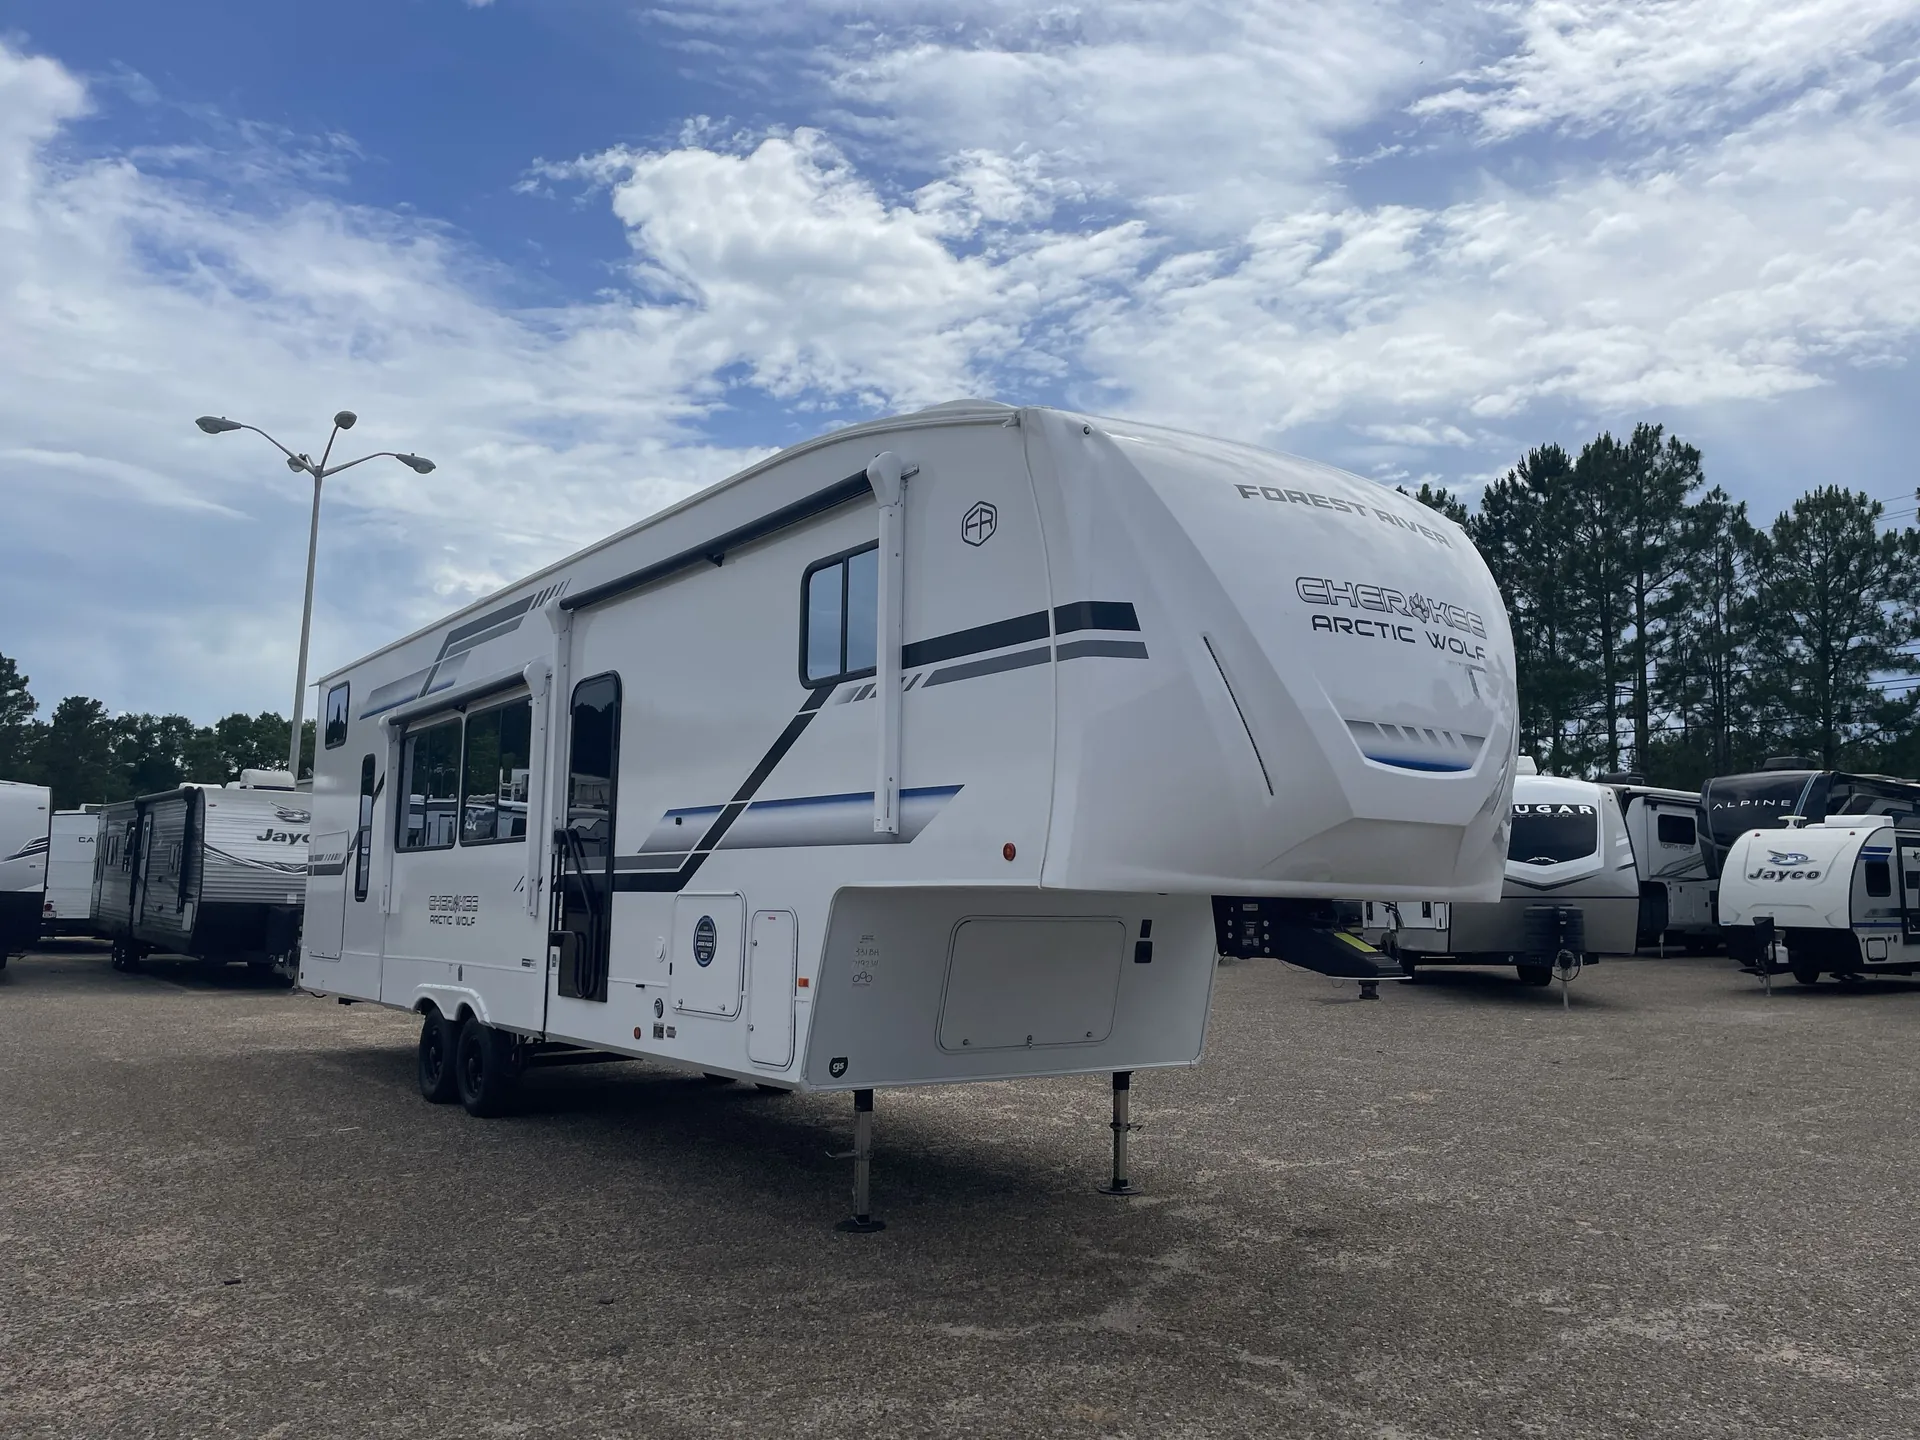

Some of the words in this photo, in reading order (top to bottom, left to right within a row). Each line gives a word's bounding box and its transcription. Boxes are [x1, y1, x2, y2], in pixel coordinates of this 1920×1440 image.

[1233, 484, 1367, 517] FOREST
[1371, 507, 1453, 549] RIVER
[1311, 614, 1416, 644] ARCTIC
[1424, 630, 1487, 660] WOLF
[1514, 804, 1594, 815] UGAR
[1713, 799, 1792, 811] ALPINE
[256, 828, 310, 845] Jayc
[1747, 867, 1822, 883] Jayco
[429, 914, 453, 925] ARCTIC
[455, 915, 476, 926] WOLF
